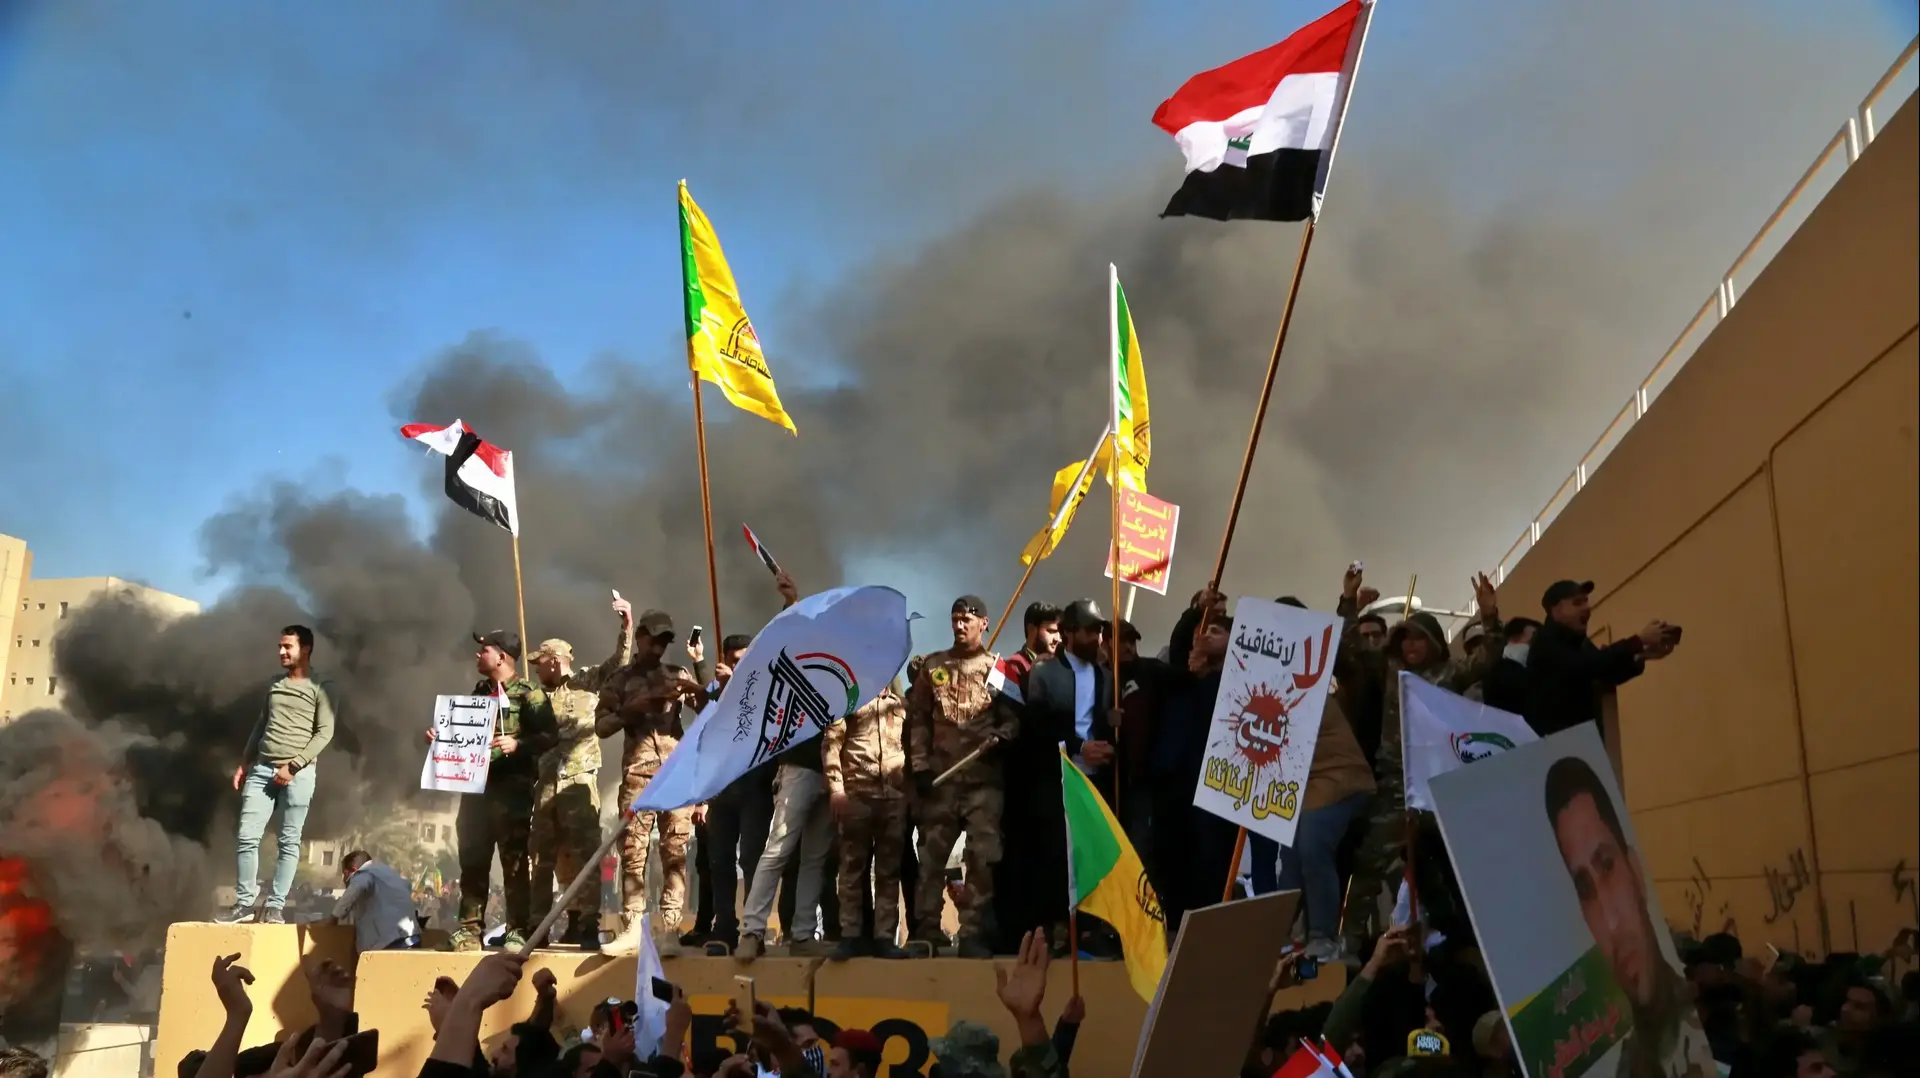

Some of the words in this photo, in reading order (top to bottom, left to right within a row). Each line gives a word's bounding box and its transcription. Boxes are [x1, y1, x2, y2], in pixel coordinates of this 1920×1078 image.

[1235, 624, 1296, 667] لاتفاقية
[1292, 624, 1333, 689] لا
[440, 715, 490, 728] السفارة
[1236, 710, 1288, 753] تبيح
[434, 769, 475, 782] الشعب
[1252, 779, 1300, 821] قتل
